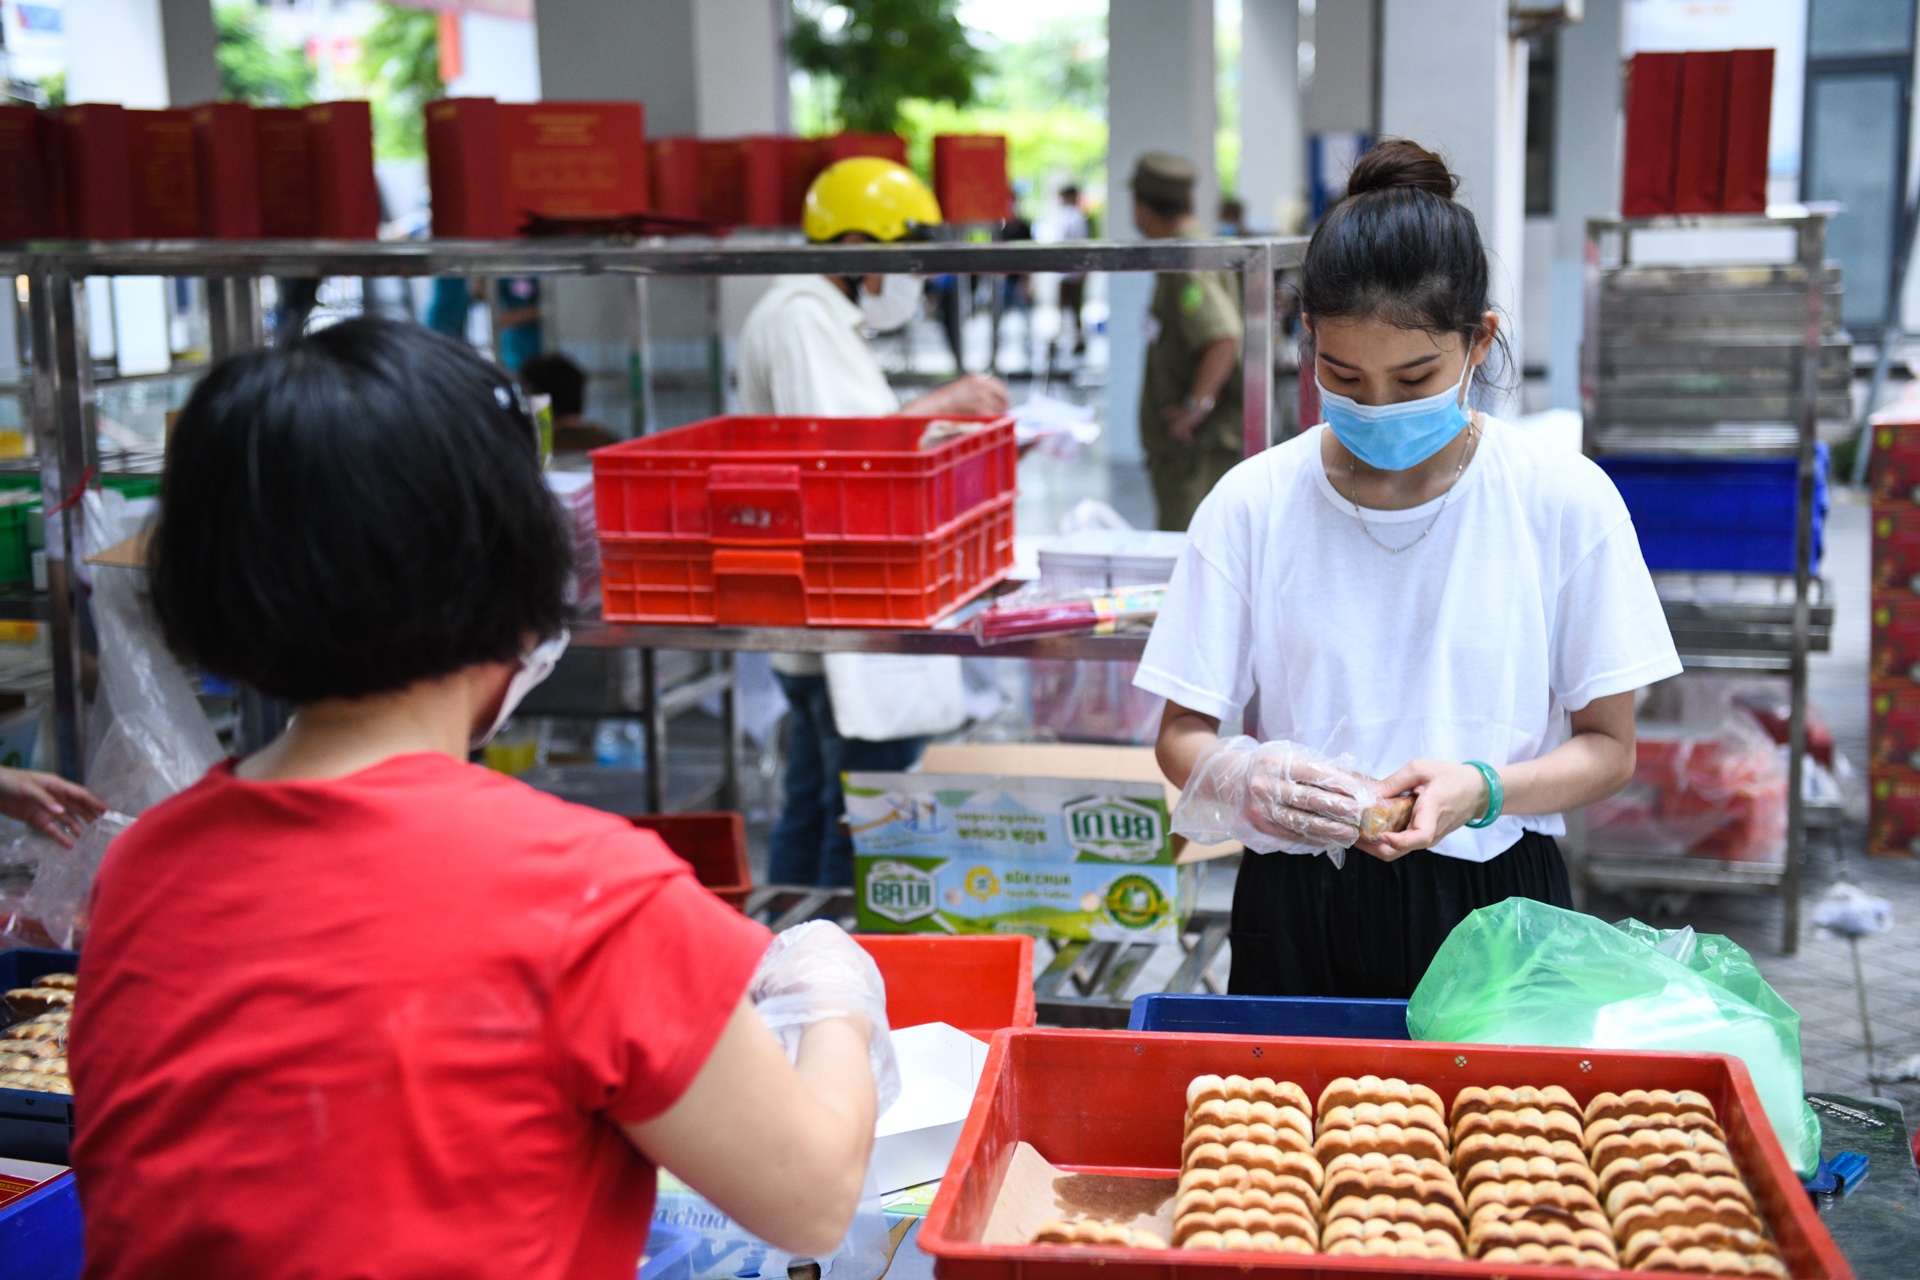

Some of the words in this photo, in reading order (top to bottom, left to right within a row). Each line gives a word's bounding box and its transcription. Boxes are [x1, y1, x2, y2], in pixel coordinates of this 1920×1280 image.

[1110, 815, 1155, 842] BA
[872, 882, 903, 906] BA
[672, 1206, 729, 1230] chua
